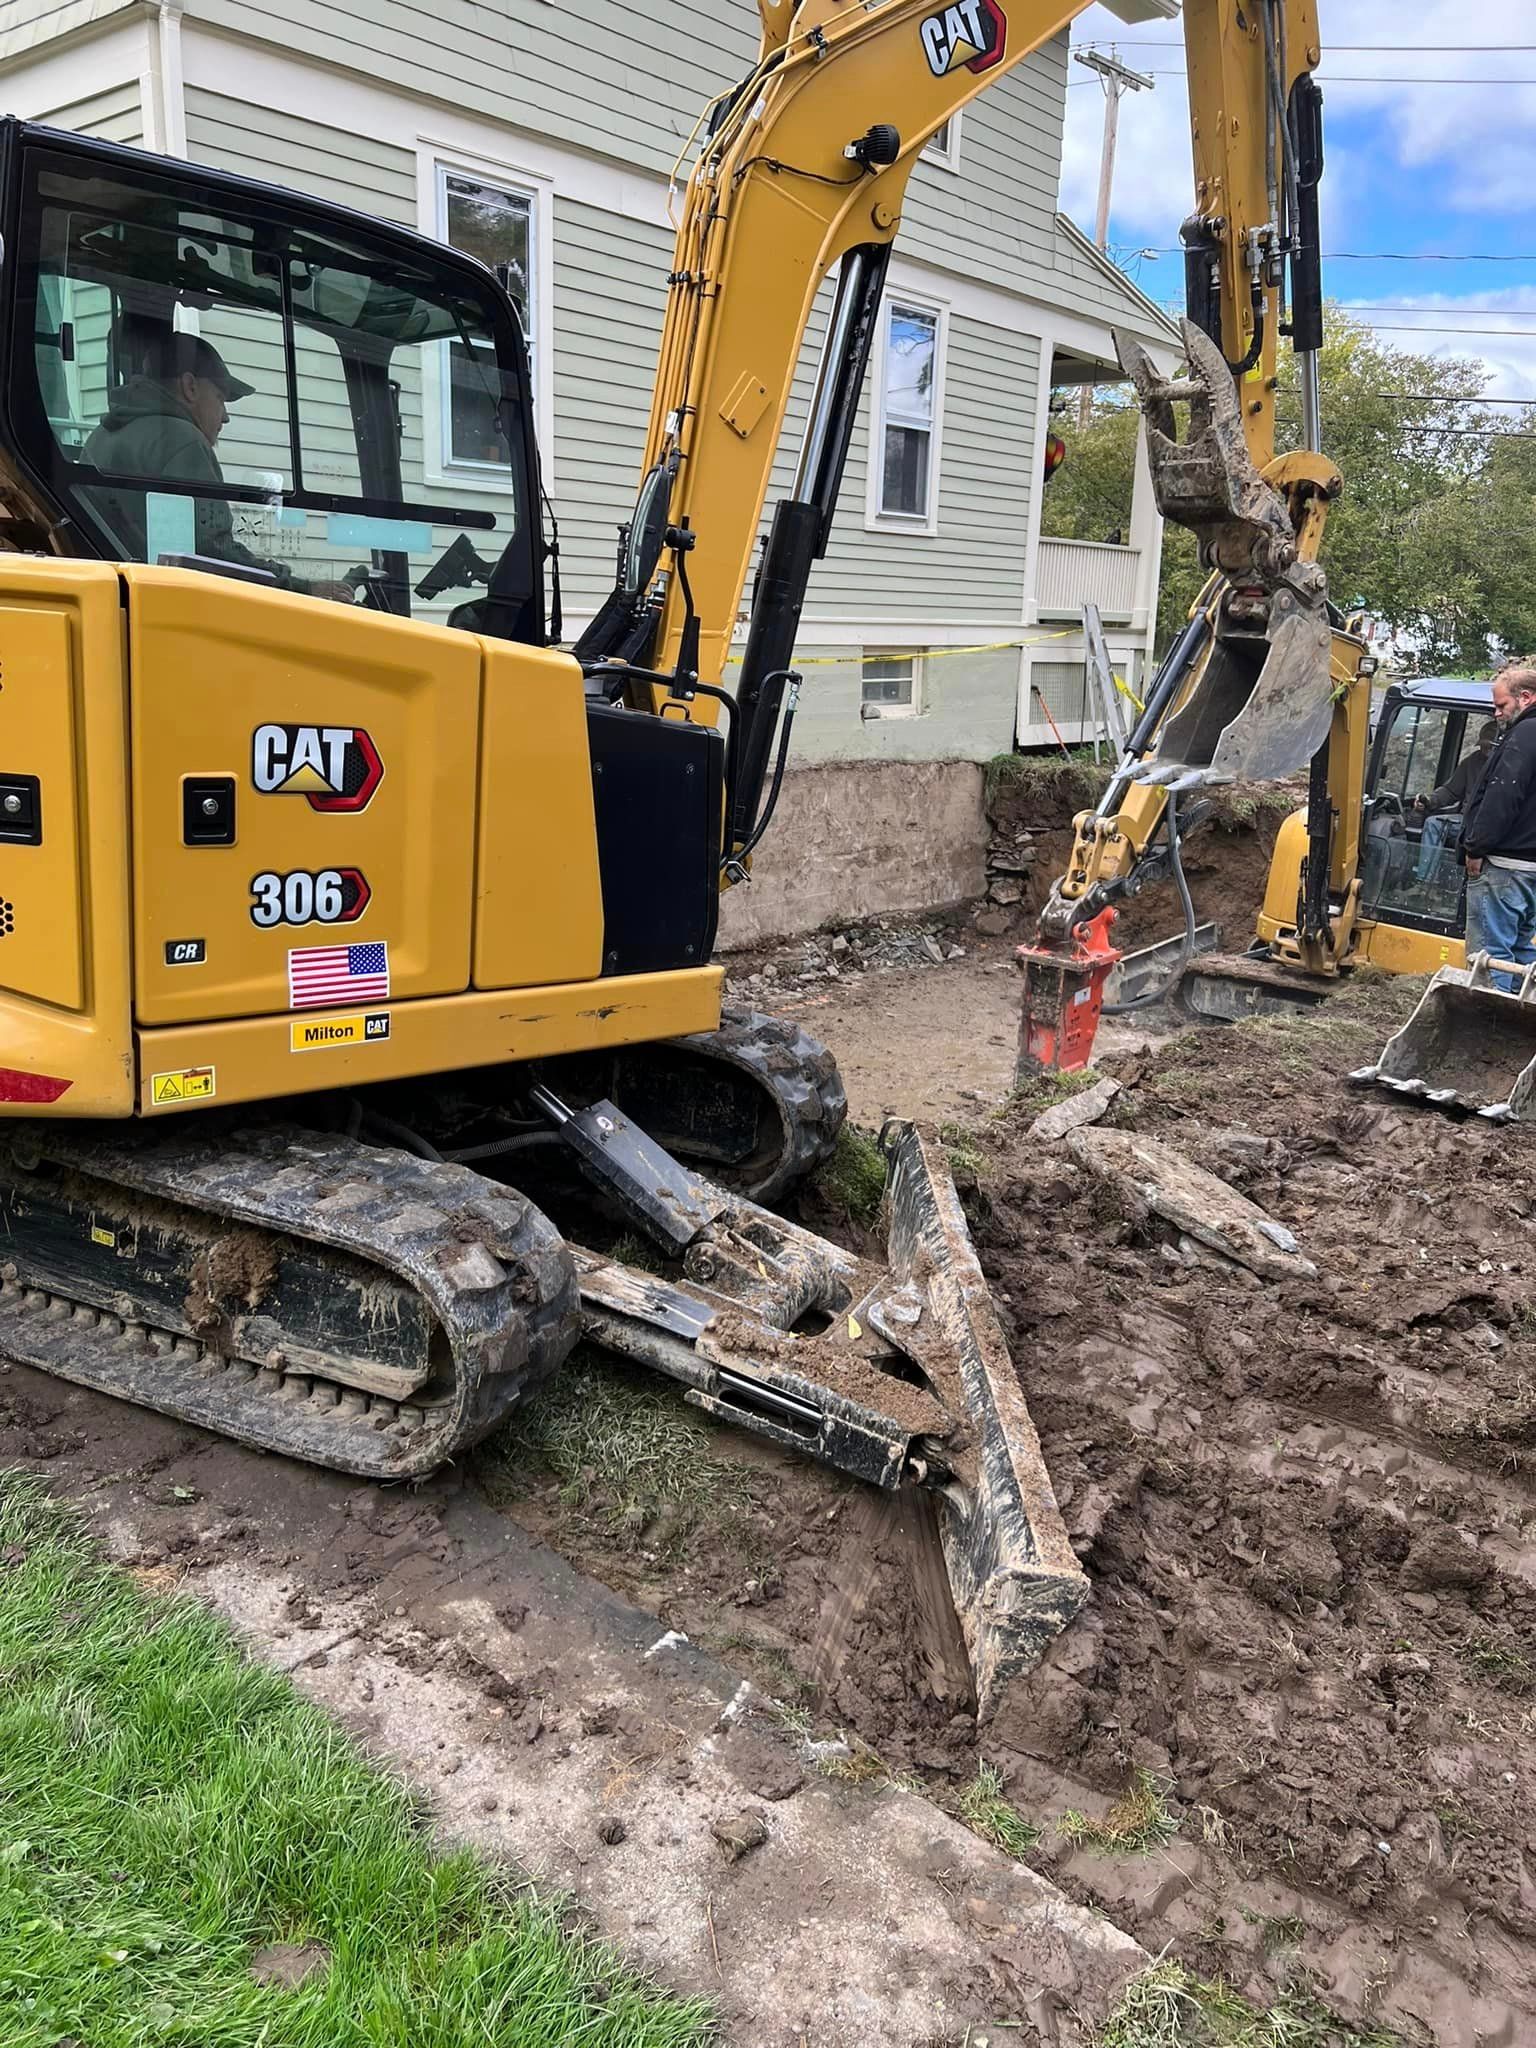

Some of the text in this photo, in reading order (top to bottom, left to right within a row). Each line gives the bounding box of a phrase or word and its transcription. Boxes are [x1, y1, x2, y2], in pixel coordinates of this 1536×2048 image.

[921, 0, 986, 74] CAT
[255, 725, 353, 792] CAT
[253, 871, 342, 924] 306
[174, 943, 198, 960] CR
[305, 1019, 388, 1042] Milton CAT
